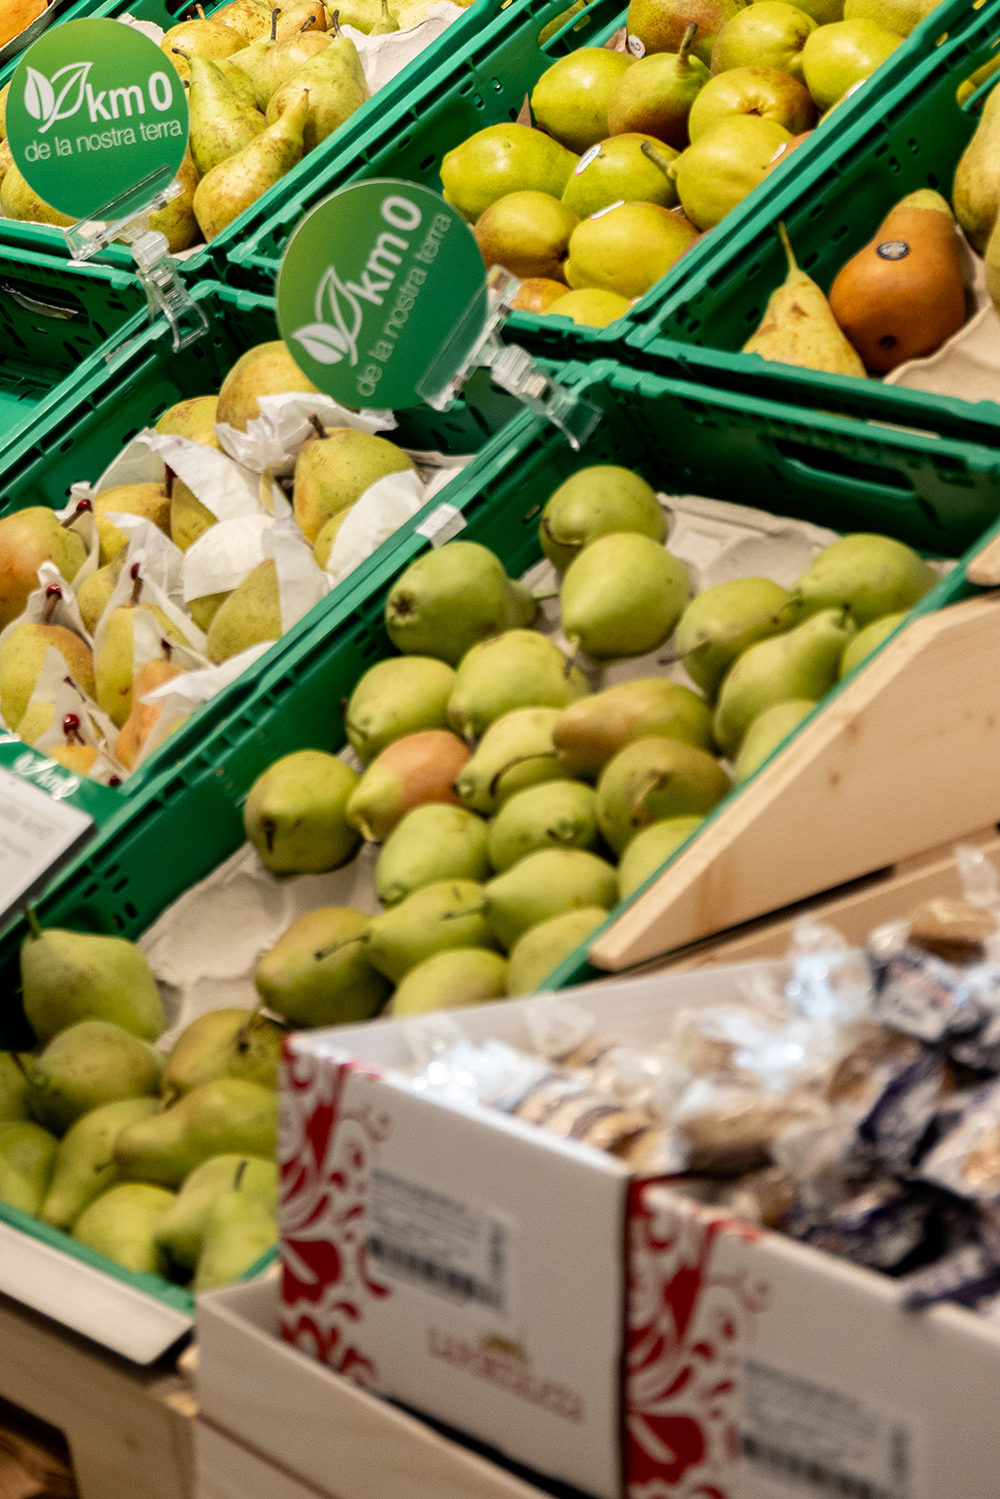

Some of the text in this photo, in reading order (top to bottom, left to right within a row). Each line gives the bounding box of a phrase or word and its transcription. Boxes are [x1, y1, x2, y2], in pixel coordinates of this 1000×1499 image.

[86, 71, 173, 122] km 0
[25, 120, 183, 162] de la nostra terra
[346, 195, 423, 306] km 0
